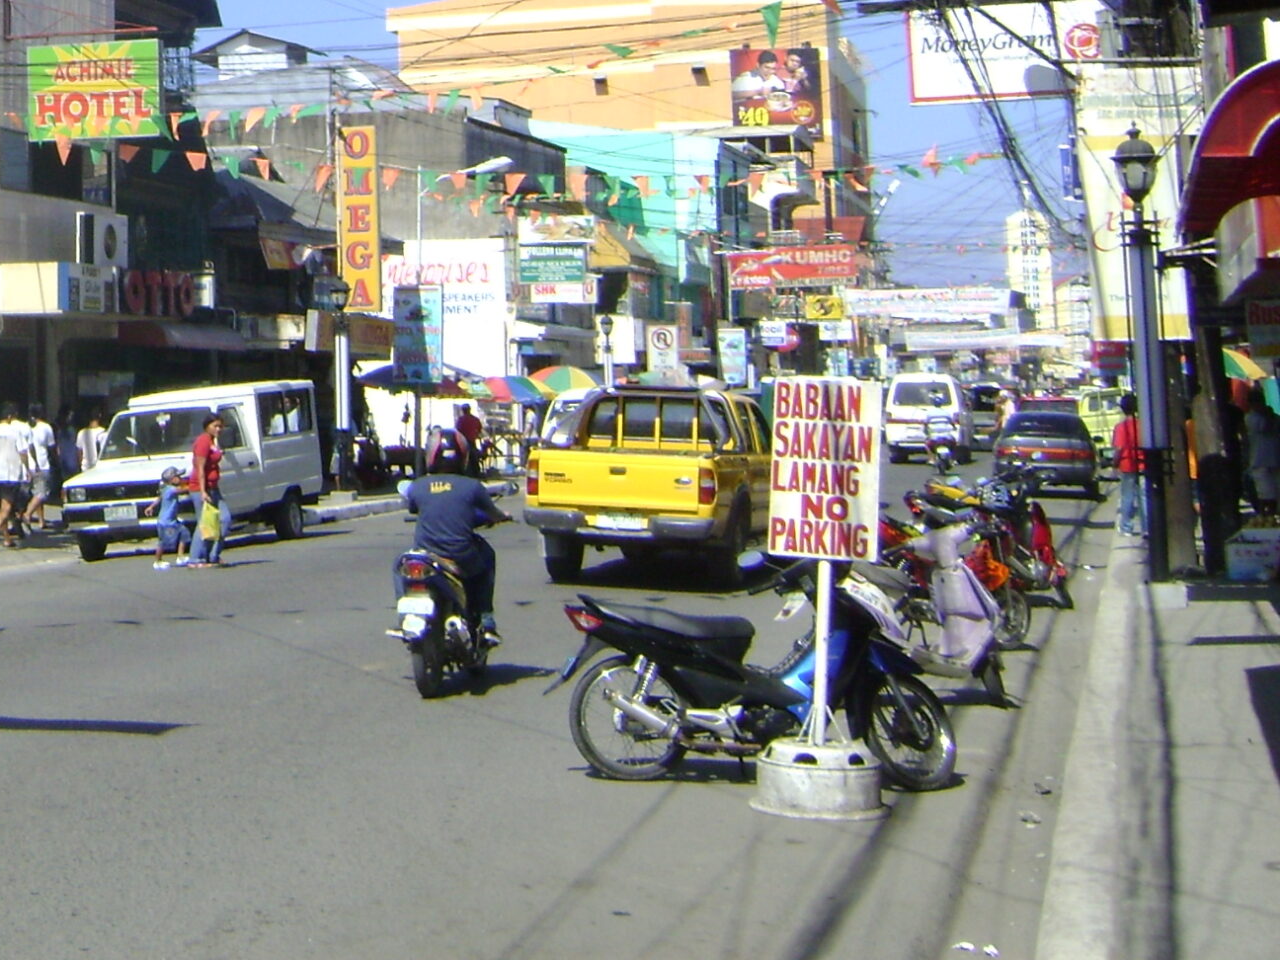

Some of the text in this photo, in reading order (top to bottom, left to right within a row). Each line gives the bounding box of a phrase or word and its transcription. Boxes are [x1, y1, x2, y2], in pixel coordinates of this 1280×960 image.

[36, 88, 152, 126] HOTEL
[343, 129, 373, 307] OMEGA
[775, 381, 862, 423] BABAAN
[774, 420, 873, 463] SAKAYAN
[772, 459, 860, 497] LAMANG
[800, 494, 849, 521] NO
[770, 516, 869, 558] PARKING
